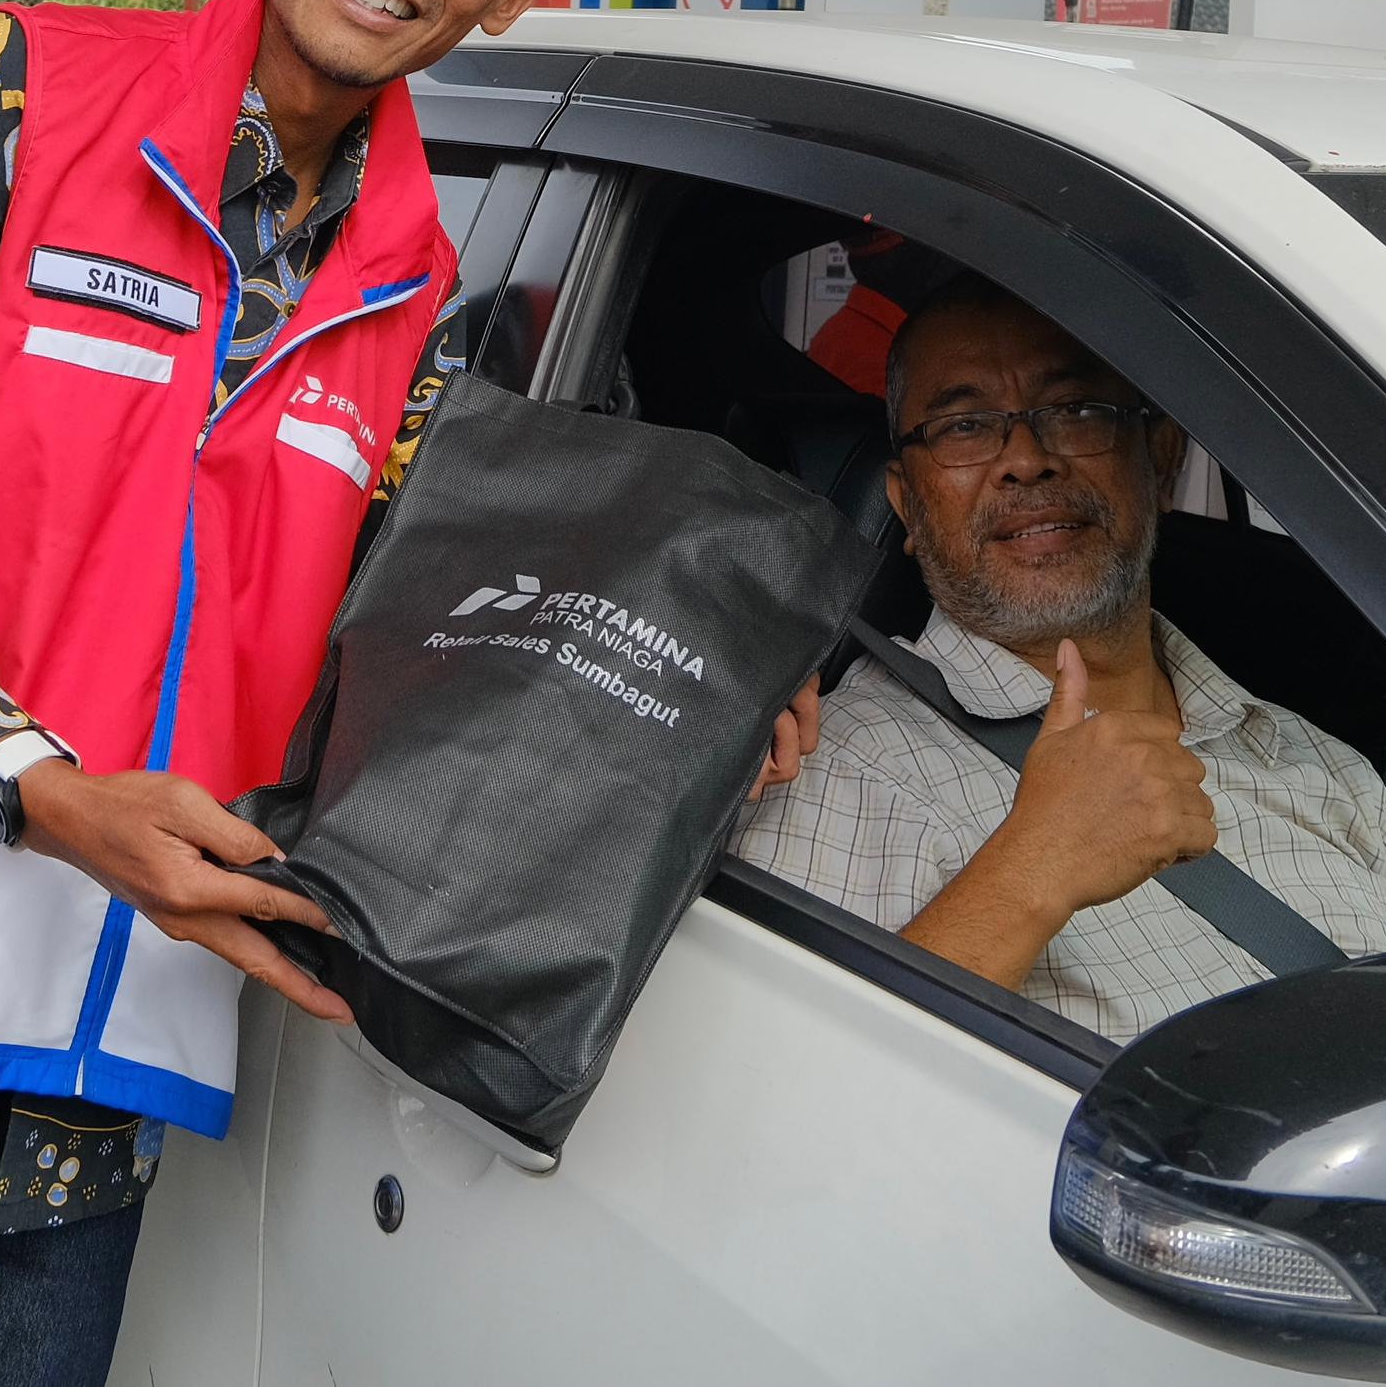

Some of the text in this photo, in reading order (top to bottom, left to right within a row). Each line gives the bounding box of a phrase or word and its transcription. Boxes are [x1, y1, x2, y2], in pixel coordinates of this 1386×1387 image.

[87, 268, 159, 308] SATRIA
[327, 394, 376, 446] PERTAIN
[530, 611, 664, 676] PATRA NIAGA
[540, 592, 704, 681] PERTAMINA
[423, 632, 681, 728] Retail Sales Sumbagut
